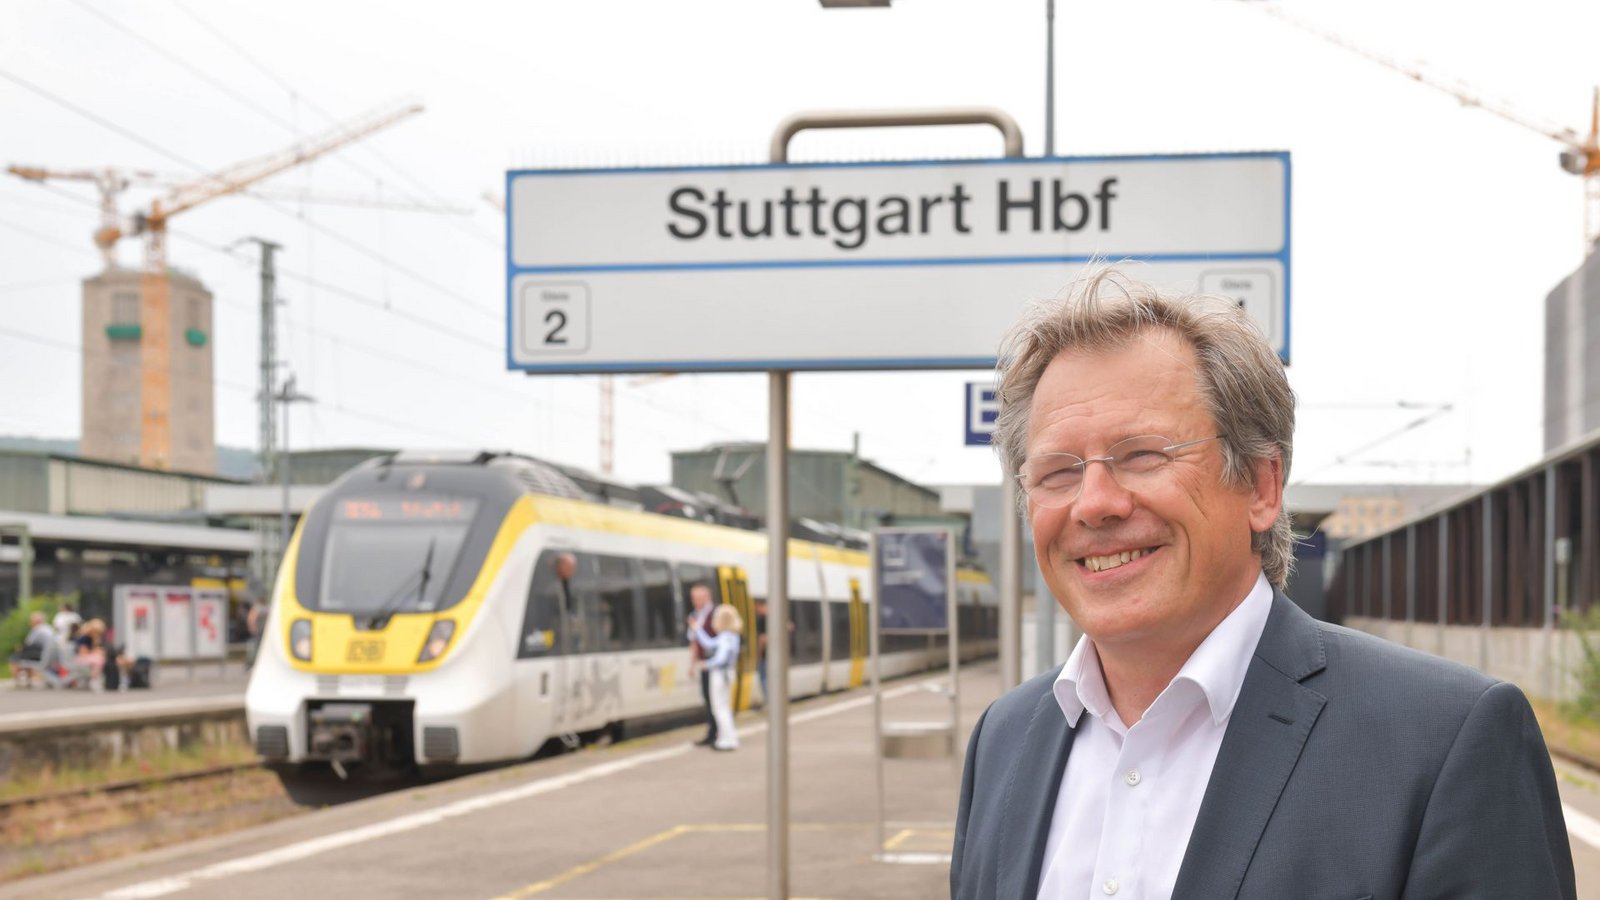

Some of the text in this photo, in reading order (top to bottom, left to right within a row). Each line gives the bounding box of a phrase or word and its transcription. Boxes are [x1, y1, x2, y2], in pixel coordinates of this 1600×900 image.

[666, 178, 1118, 249] Stuttgart Hbf
[544, 310, 567, 344] 2
